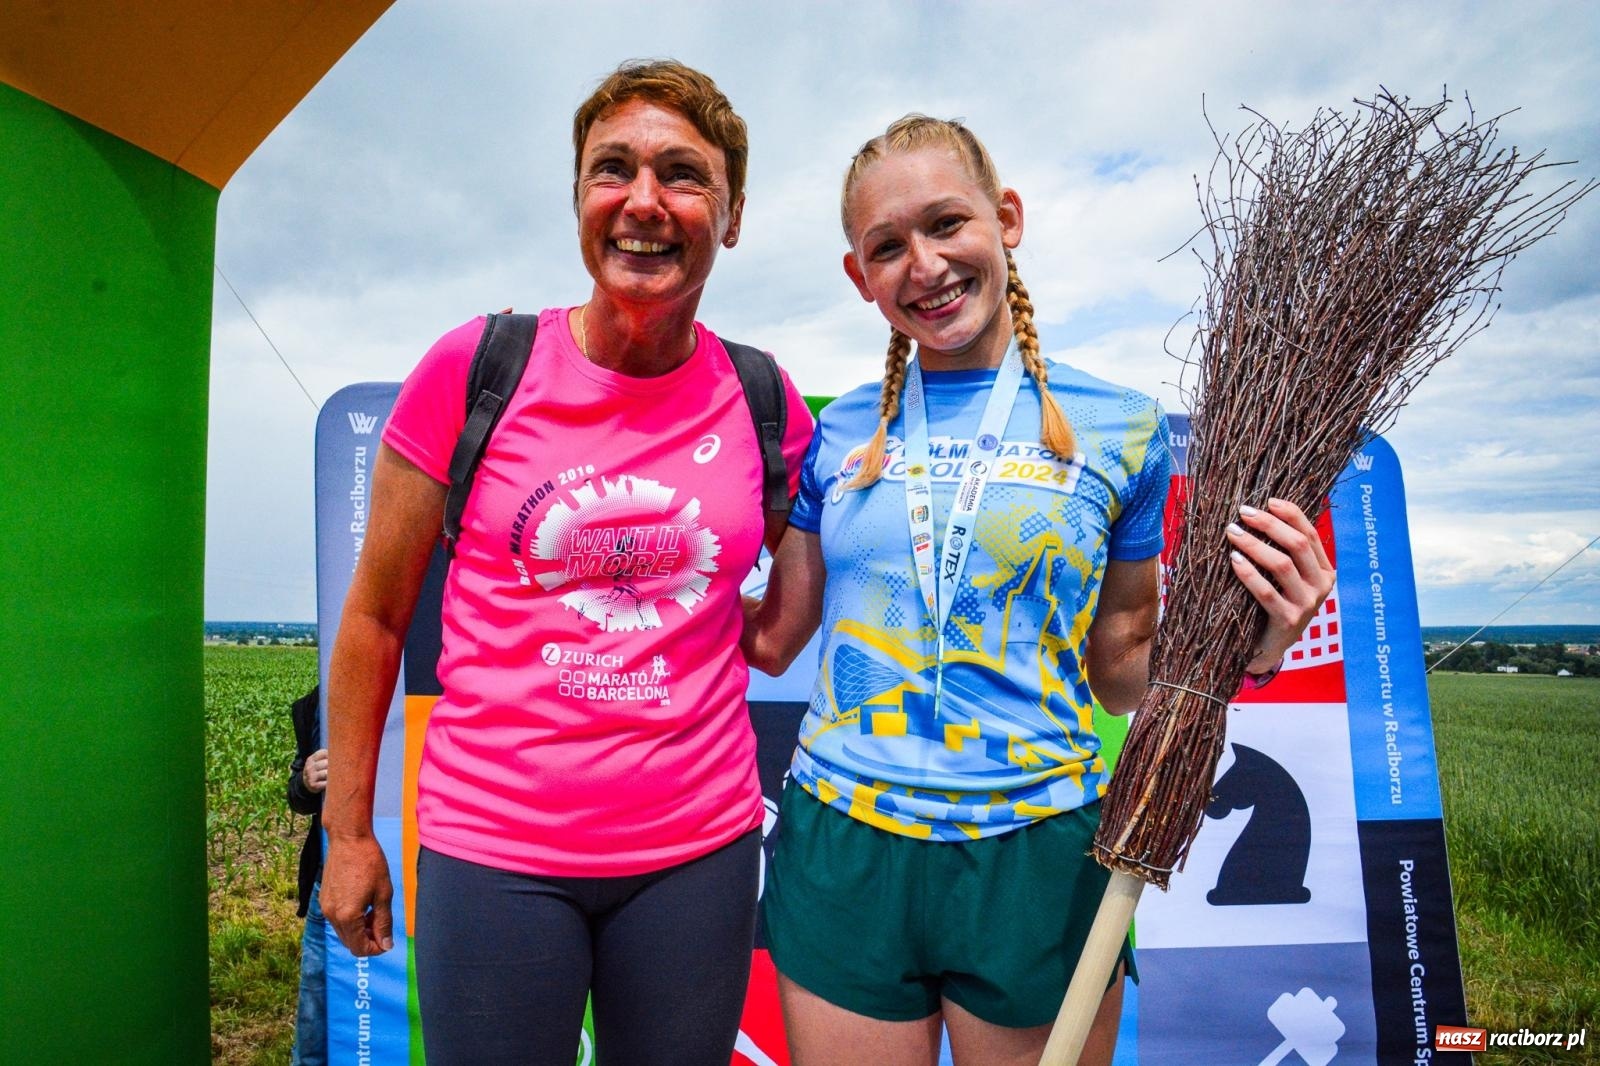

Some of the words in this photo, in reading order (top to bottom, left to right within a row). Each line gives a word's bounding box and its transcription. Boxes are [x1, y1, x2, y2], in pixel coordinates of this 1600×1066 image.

[350, 446, 367, 533] Raciborzu
[998, 461, 1069, 486] 2024
[966, 477, 980, 512] AKADEMIA
[509, 479, 555, 555] MARATHON
[1360, 484, 1379, 569] Powiatowe
[572, 526, 656, 554] WANT
[656, 525, 685, 551] IT
[566, 551, 680, 579] MORE
[1370, 572, 1387, 641] Centrum
[562, 650, 624, 668] ZURICH
[1376, 644, 1393, 699] Sportu
[587, 670, 648, 687] MARATÓ
[587, 686, 670, 701] BARCELONA
[1382, 702, 1395, 718] w
[1384, 720, 1403, 805] Raciborzu
[1399, 860, 1419, 960] Powiatowe
[1410, 963, 1429, 1044] Centrum
